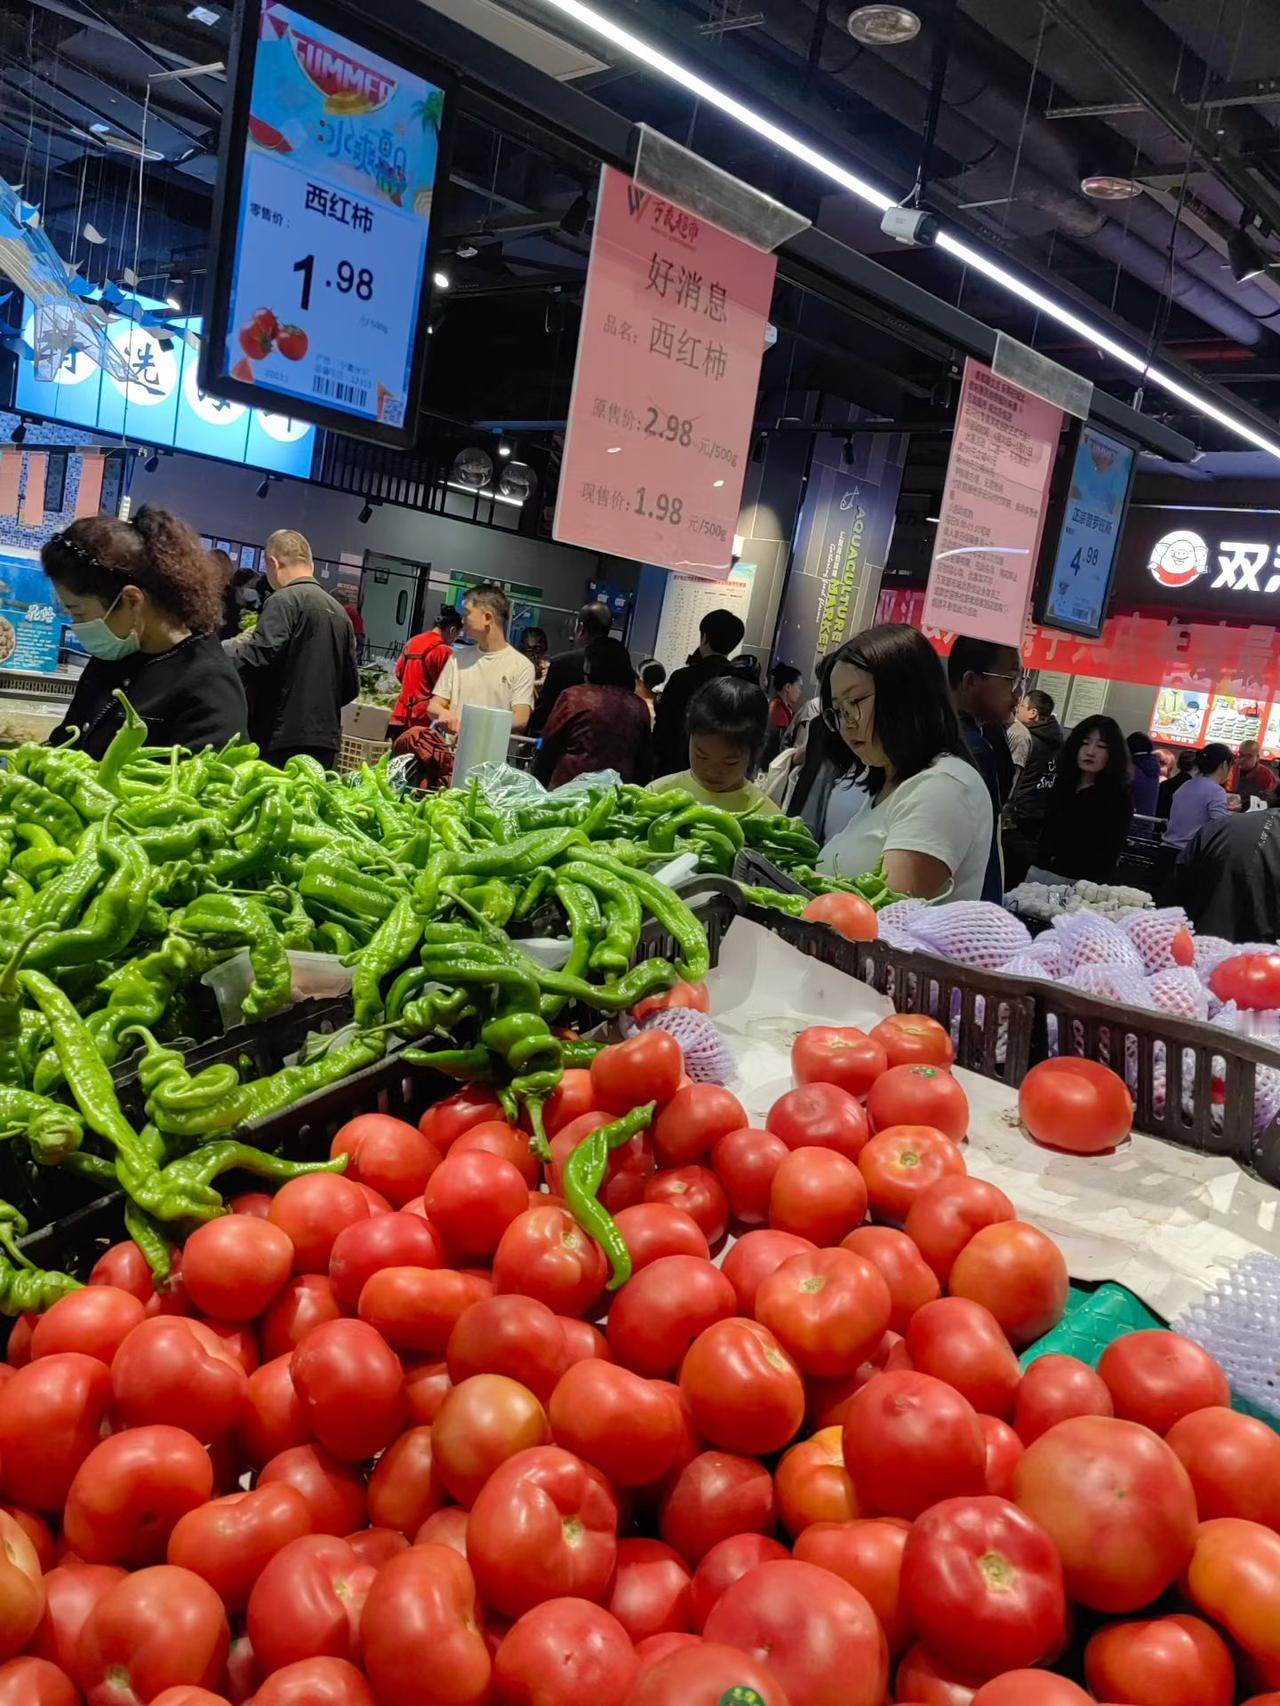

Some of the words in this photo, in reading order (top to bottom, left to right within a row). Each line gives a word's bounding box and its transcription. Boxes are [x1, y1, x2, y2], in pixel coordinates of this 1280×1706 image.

[305, 182, 375, 234] 西红柿
[293, 254, 374, 311] 1.98
[644, 252, 727, 323] 好消息
[649, 317, 728, 381] 西红柿
[643, 406, 693, 448] 2.98
[699, 438, 739, 467] 元/500g
[633, 487, 683, 526] 1.98
[688, 515, 728, 542] 元/500g
[832, 504, 866, 644] AQUACULTURE
[1070, 546, 1099, 577] 4.98
[816, 577, 841, 656] MARKET
